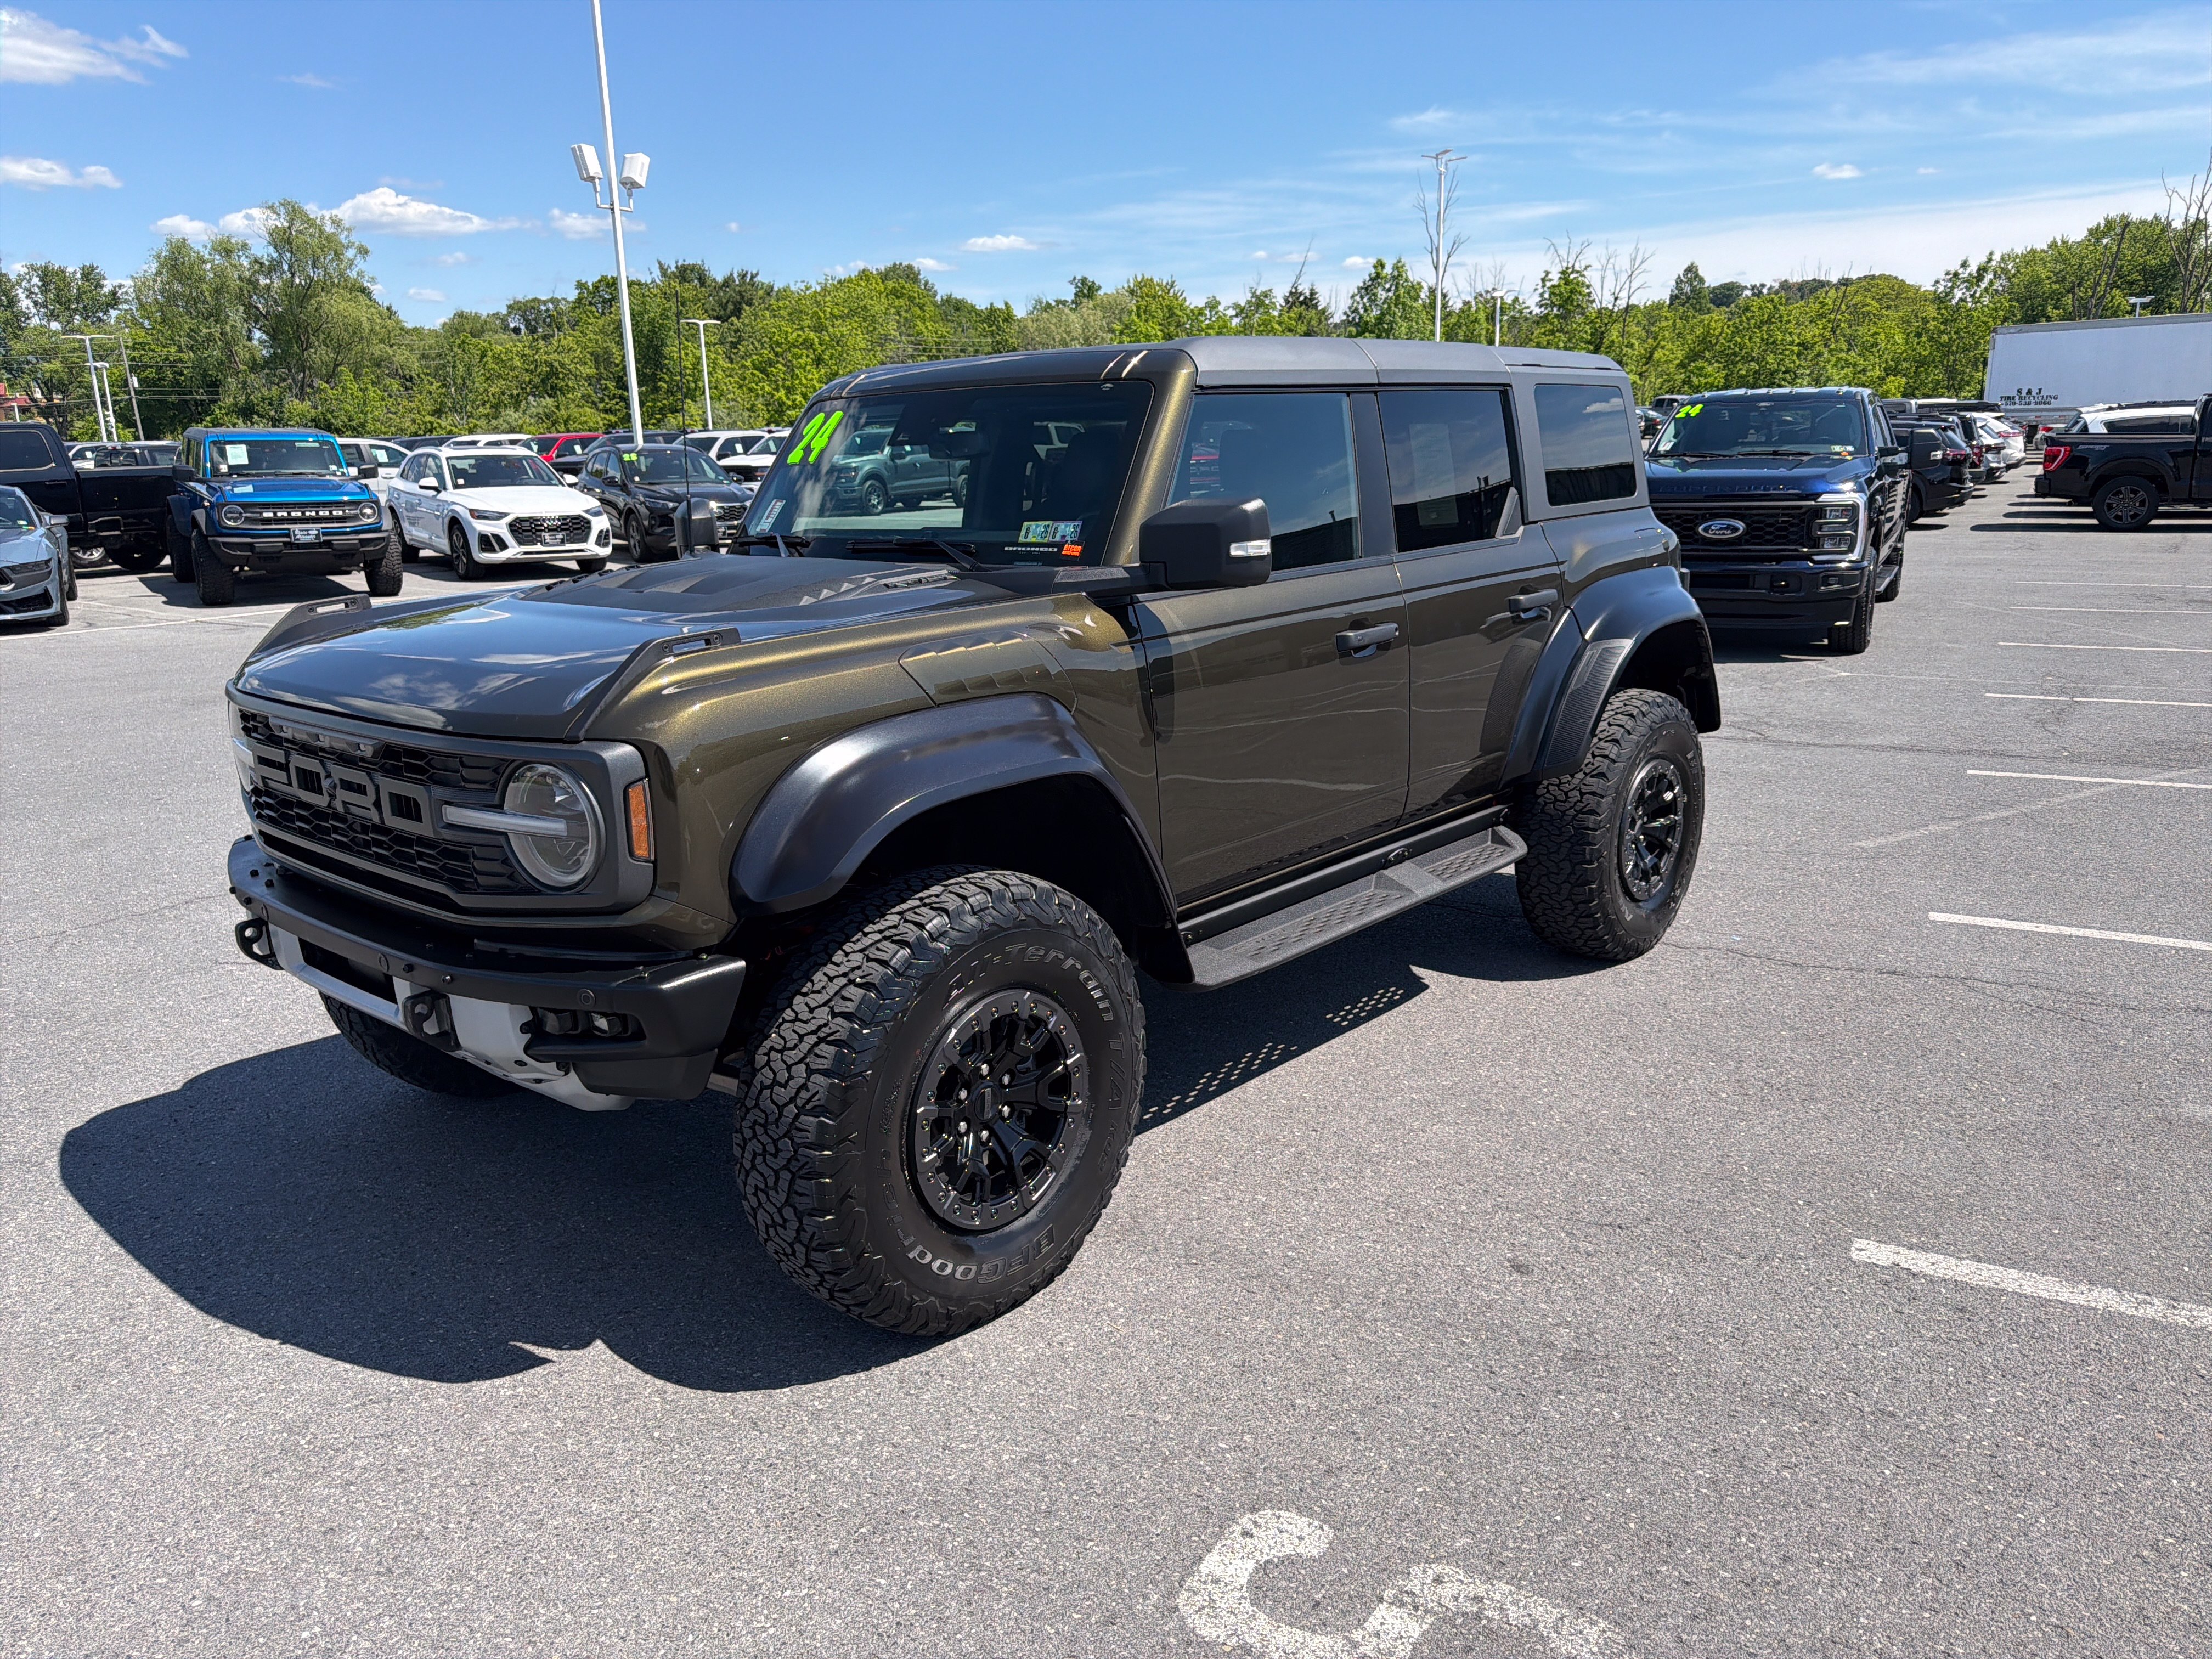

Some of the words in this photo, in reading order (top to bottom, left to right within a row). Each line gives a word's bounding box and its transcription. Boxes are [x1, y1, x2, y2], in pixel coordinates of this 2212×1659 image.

[1675, 404, 1705, 418] 24
[787, 410, 844, 465] 24
[1024, 527, 1030, 539] 6
[1040, 524, 1051, 539] 26
[1052, 527, 1058, 539] 6
[1070, 524, 1080, 539] 26
[252, 743, 435, 838] FORD
[876, 1148, 1056, 1284] BFGoodrich
